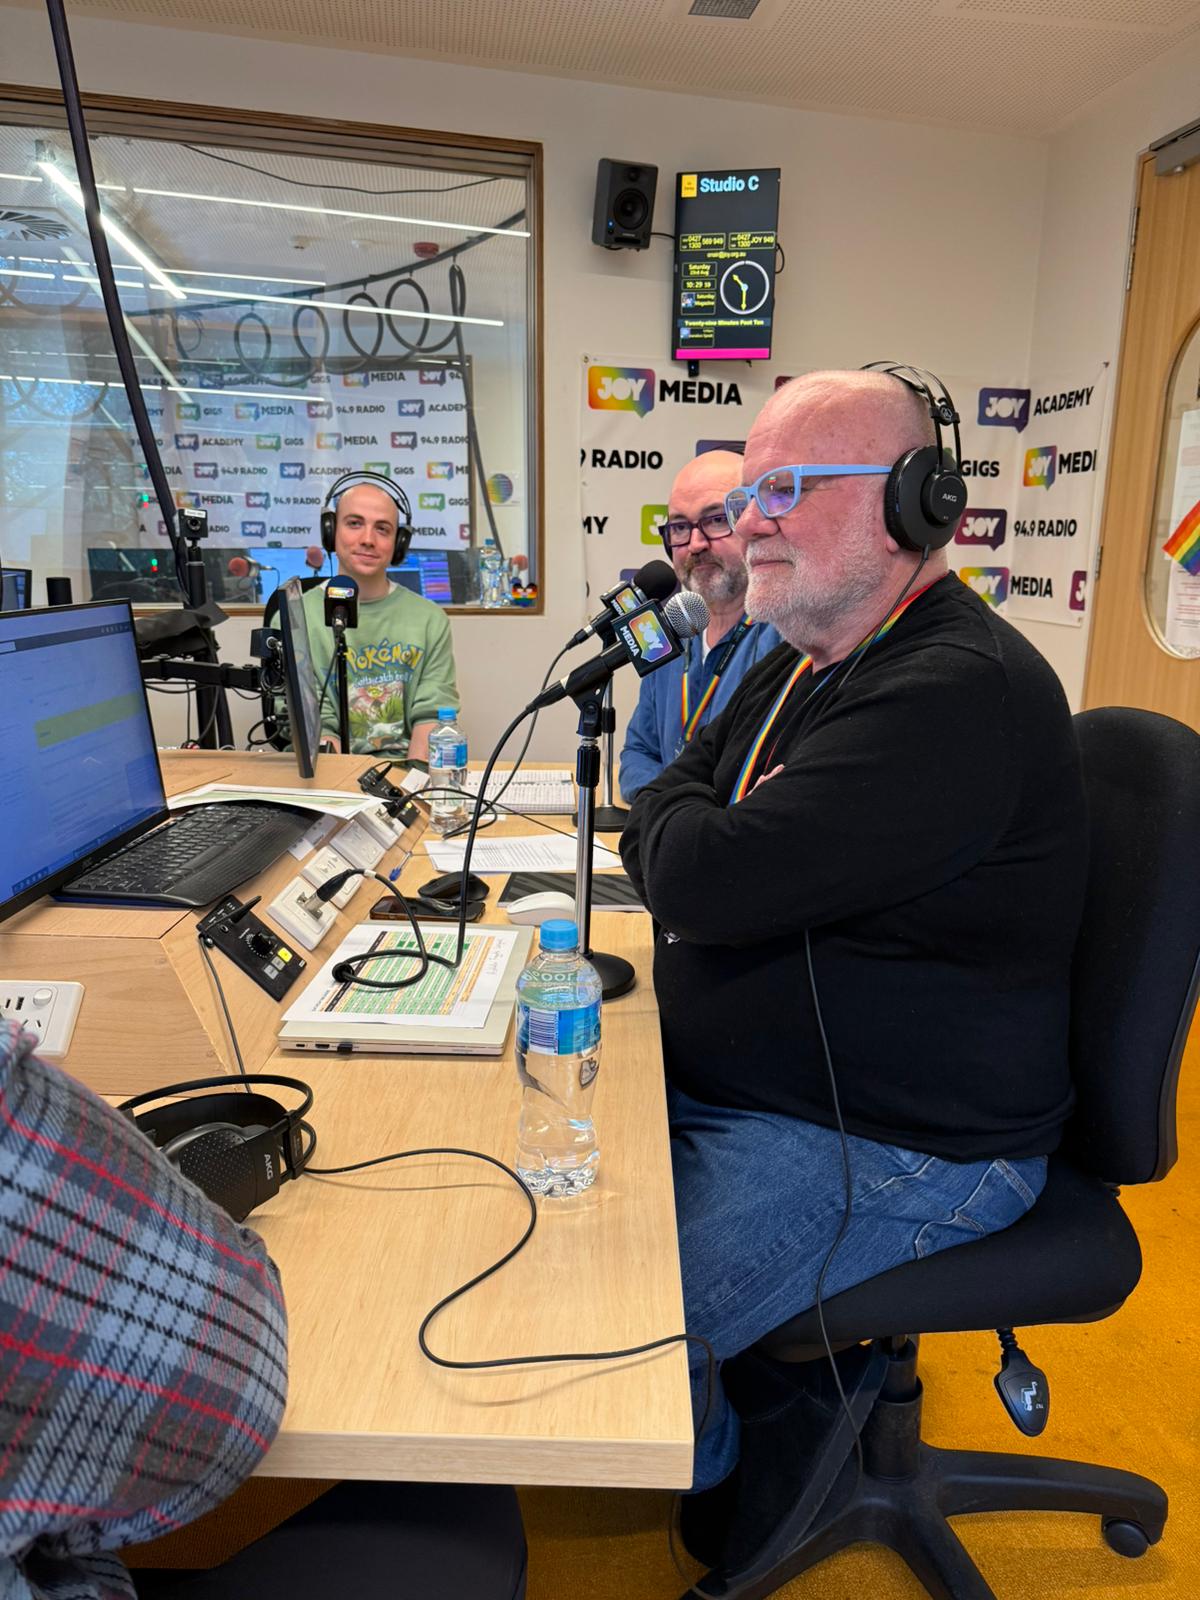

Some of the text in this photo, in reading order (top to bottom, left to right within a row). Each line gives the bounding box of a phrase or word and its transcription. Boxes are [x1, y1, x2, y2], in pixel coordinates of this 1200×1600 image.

[700, 175, 746, 192] Studio
[747, 175, 760, 191] C
[751, 236, 763, 244] JOY
[688, 264, 712, 272] Saturday
[371, 372, 406, 382] MEDIA
[597, 377, 743, 406] JOY MEDIA
[985, 386, 1095, 419] JOY ACADEMY
[261, 406, 295, 416] MEDIA
[336, 406, 355, 414] 94.9
[356, 405, 386, 414] RADIO
[400, 402, 467, 414] JOY ACADEM
[202, 438, 244, 447] ACADEMY
[284, 438, 304, 446] GIGS
[344, 436, 378, 445] MEDIA
[420, 436, 440, 444] 94.9
[591, 449, 664, 470] RADIO
[1027, 449, 1097, 478] JOY MEDI
[240, 467, 268, 475] RADIO
[308, 467, 352, 475] ACADEMY
[394, 467, 415, 475] GIGS
[961, 460, 1000, 478] GIGS
[202, 496, 234, 504] MEDIA
[292, 497, 321, 505] RADIO
[942, 493, 957, 502] AKG
[269, 526, 312, 534] ACADEMY
[412, 527, 447, 536] MEDIA
[962, 516, 1078, 538] JOY 94.9 RADIO
[967, 575, 1002, 596] JOY
[1010, 576, 1053, 599] MEDIA
[638, 621, 664, 650] JOY
[620, 625, 640, 657] MEDIA
[263, 1153, 274, 1180] AKG
